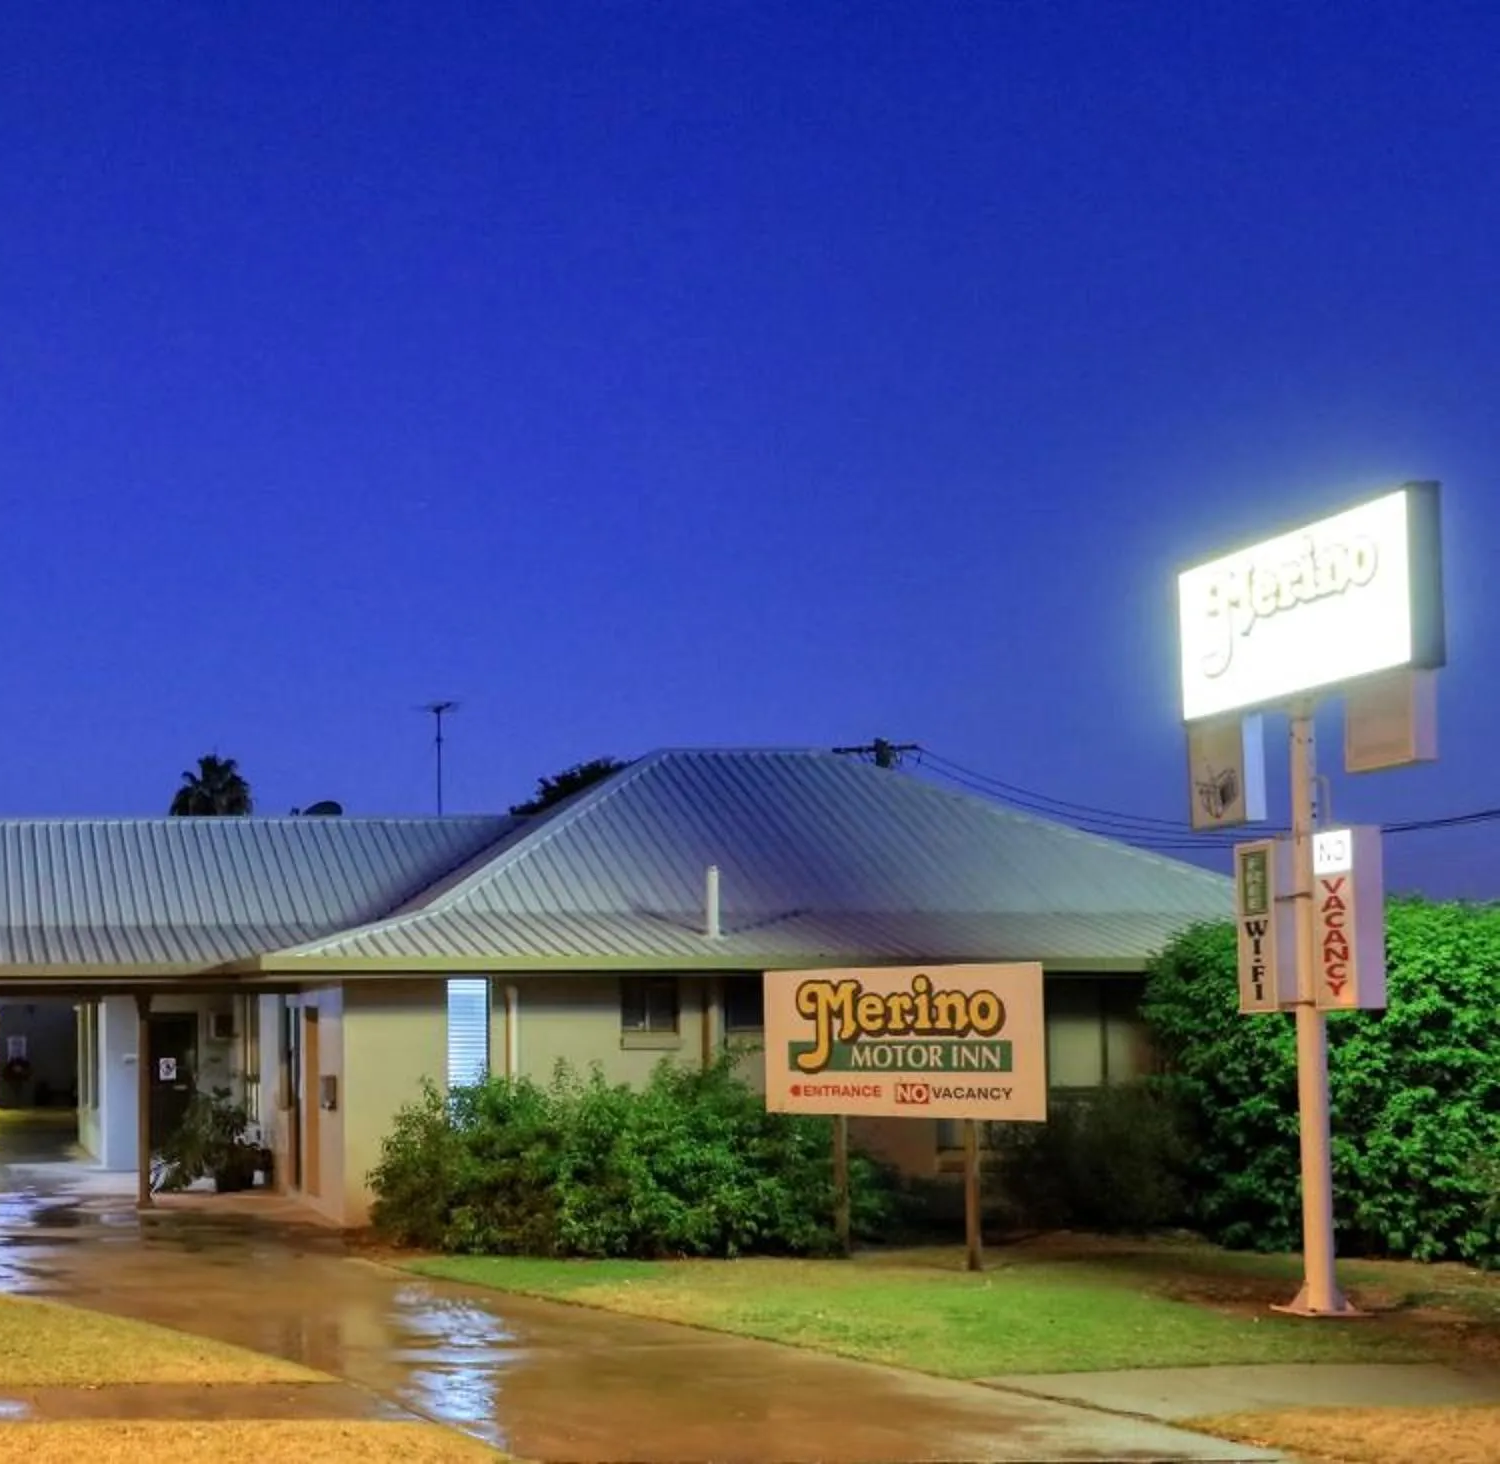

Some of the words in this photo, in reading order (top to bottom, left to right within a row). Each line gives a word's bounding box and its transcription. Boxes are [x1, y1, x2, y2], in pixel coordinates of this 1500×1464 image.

[1319, 838, 1347, 863] NO
[1320, 877, 1349, 998] VACANCY
[795, 973, 1007, 1075] Merino
[850, 1044, 944, 1069] MOTOR
[951, 1045, 1002, 1069] INN
[803, 1084, 882, 1098] ENTRANCE
[897, 1085, 929, 1103] NO
[931, 1086, 1013, 1101] VACANCY
